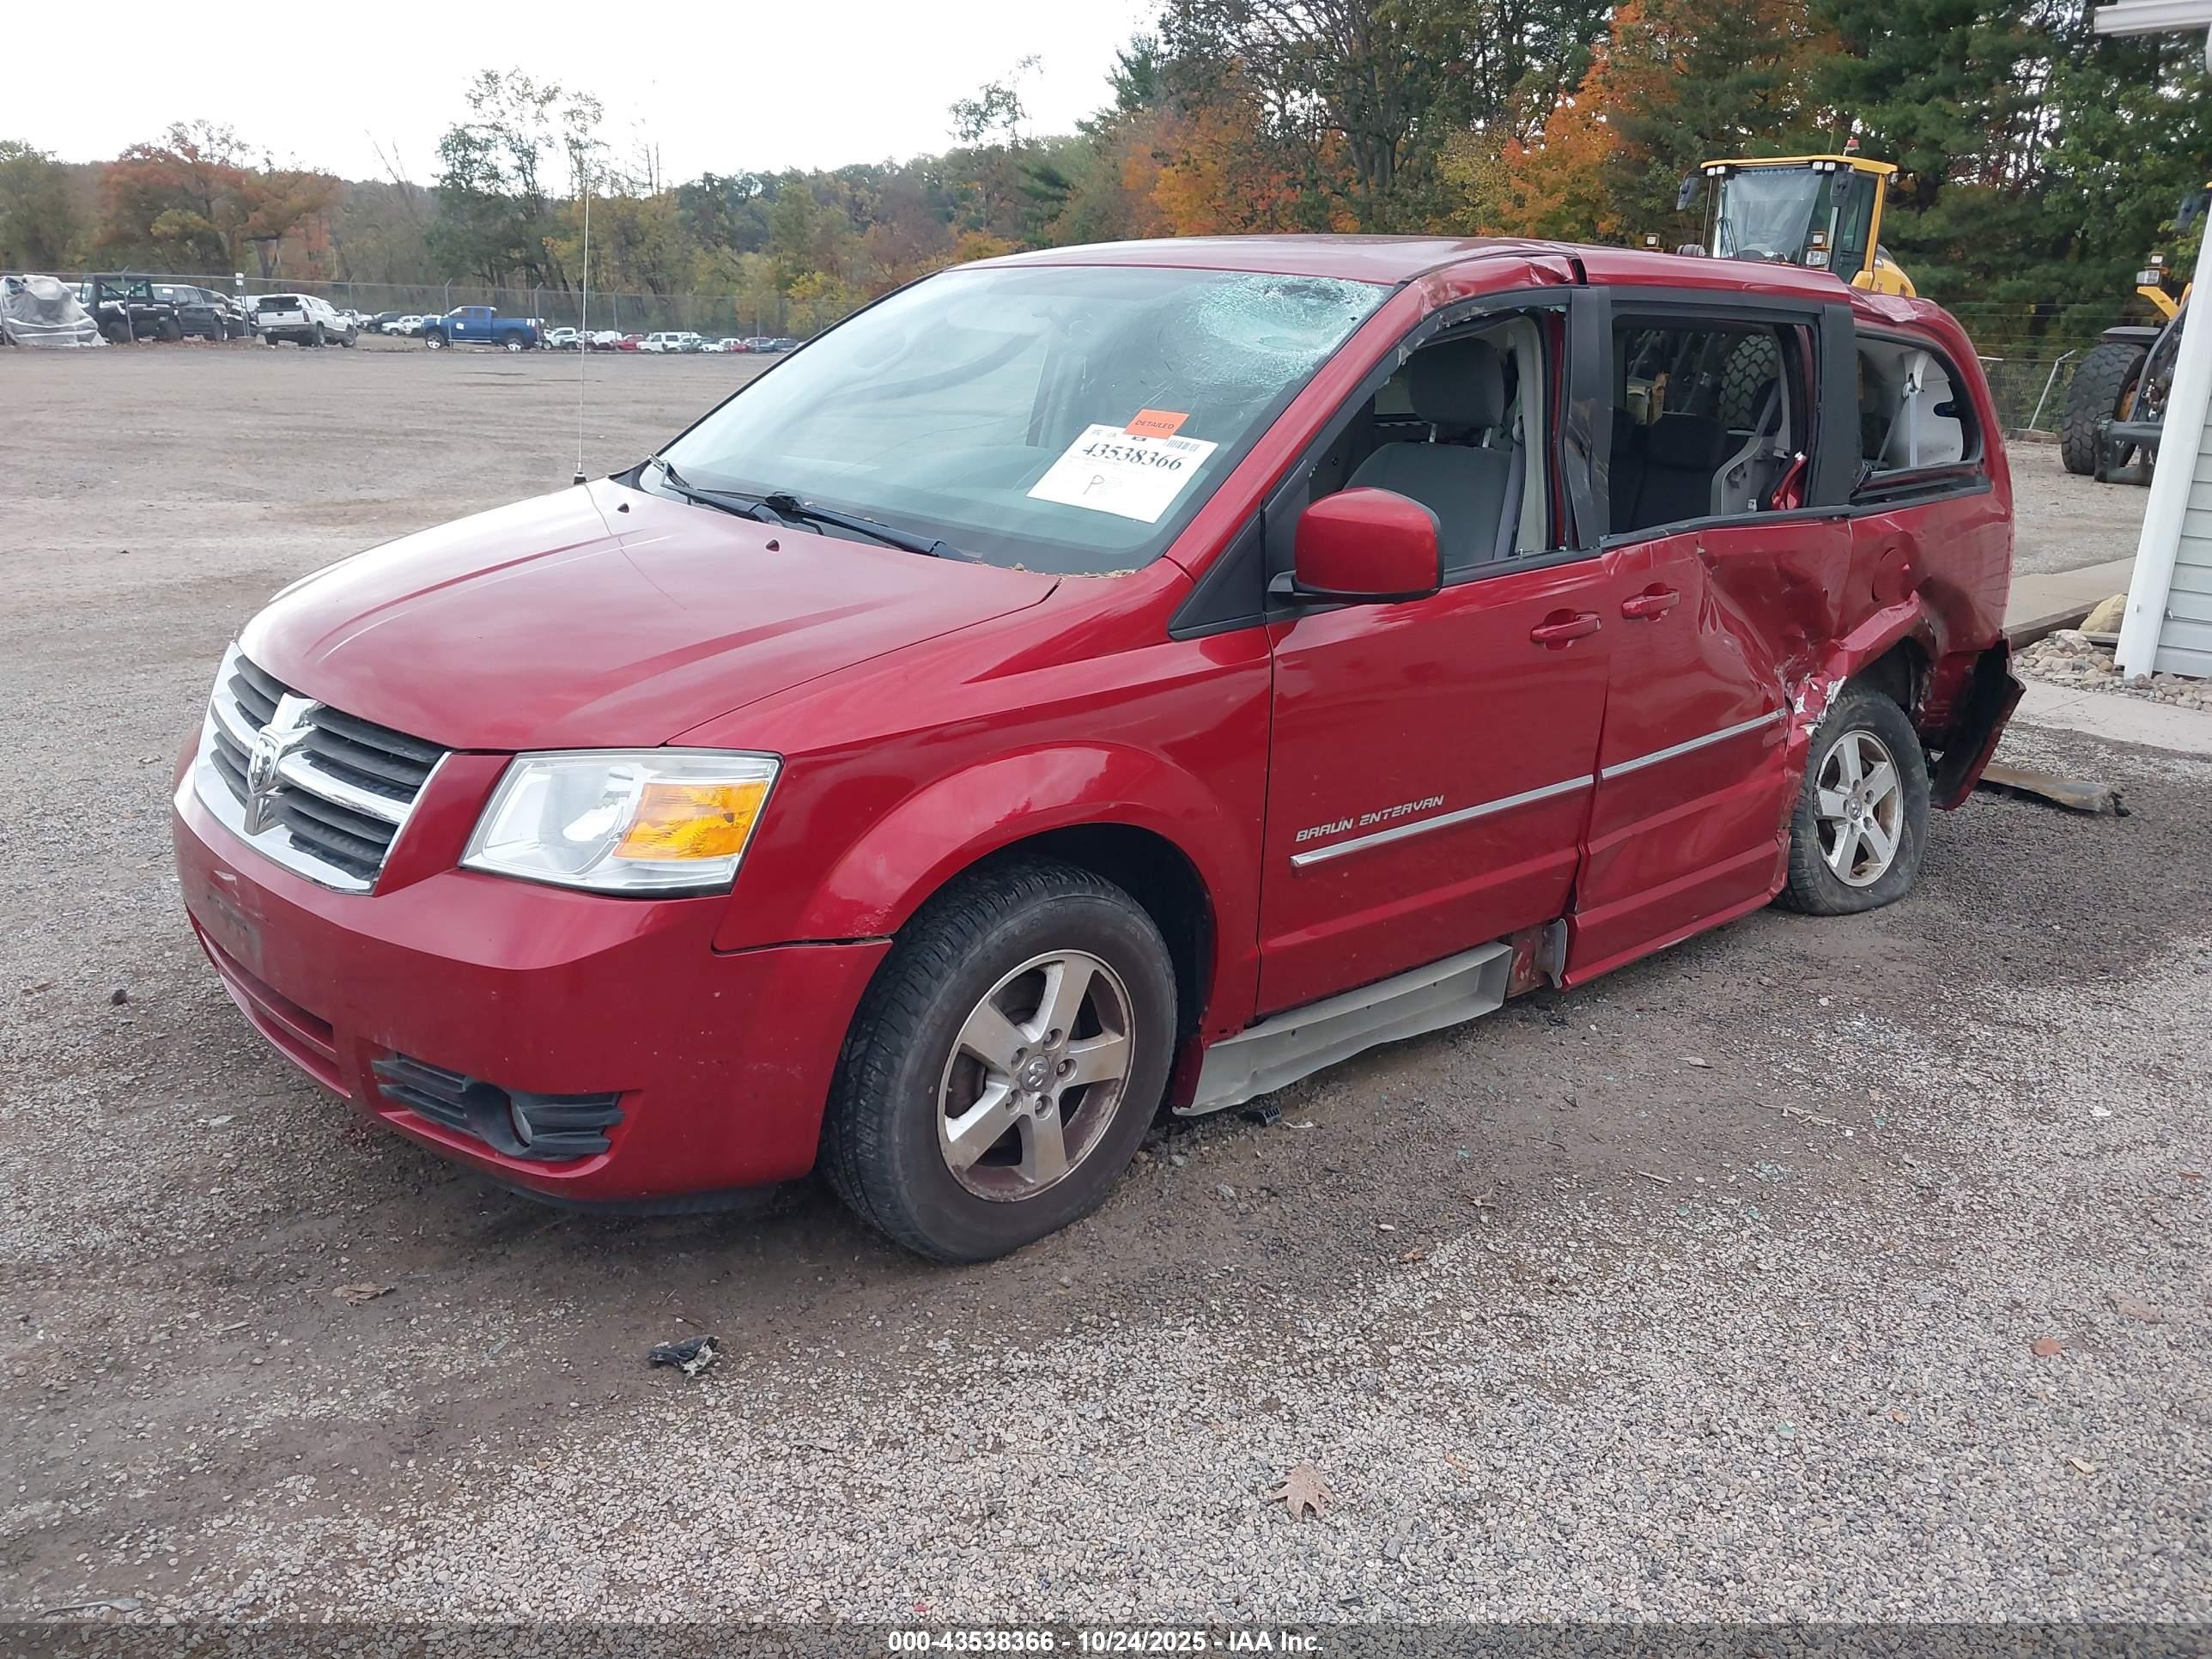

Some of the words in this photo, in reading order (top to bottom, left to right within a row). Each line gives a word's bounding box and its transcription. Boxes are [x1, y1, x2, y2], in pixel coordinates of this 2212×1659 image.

[1134, 419, 1175, 429] DETAILED
[1082, 442, 1188, 471] 43538366
[1082, 474, 1105, 495] P
[1295, 818, 1354, 842] BRAUN
[1359, 794, 1444, 826] ENTERVAN
